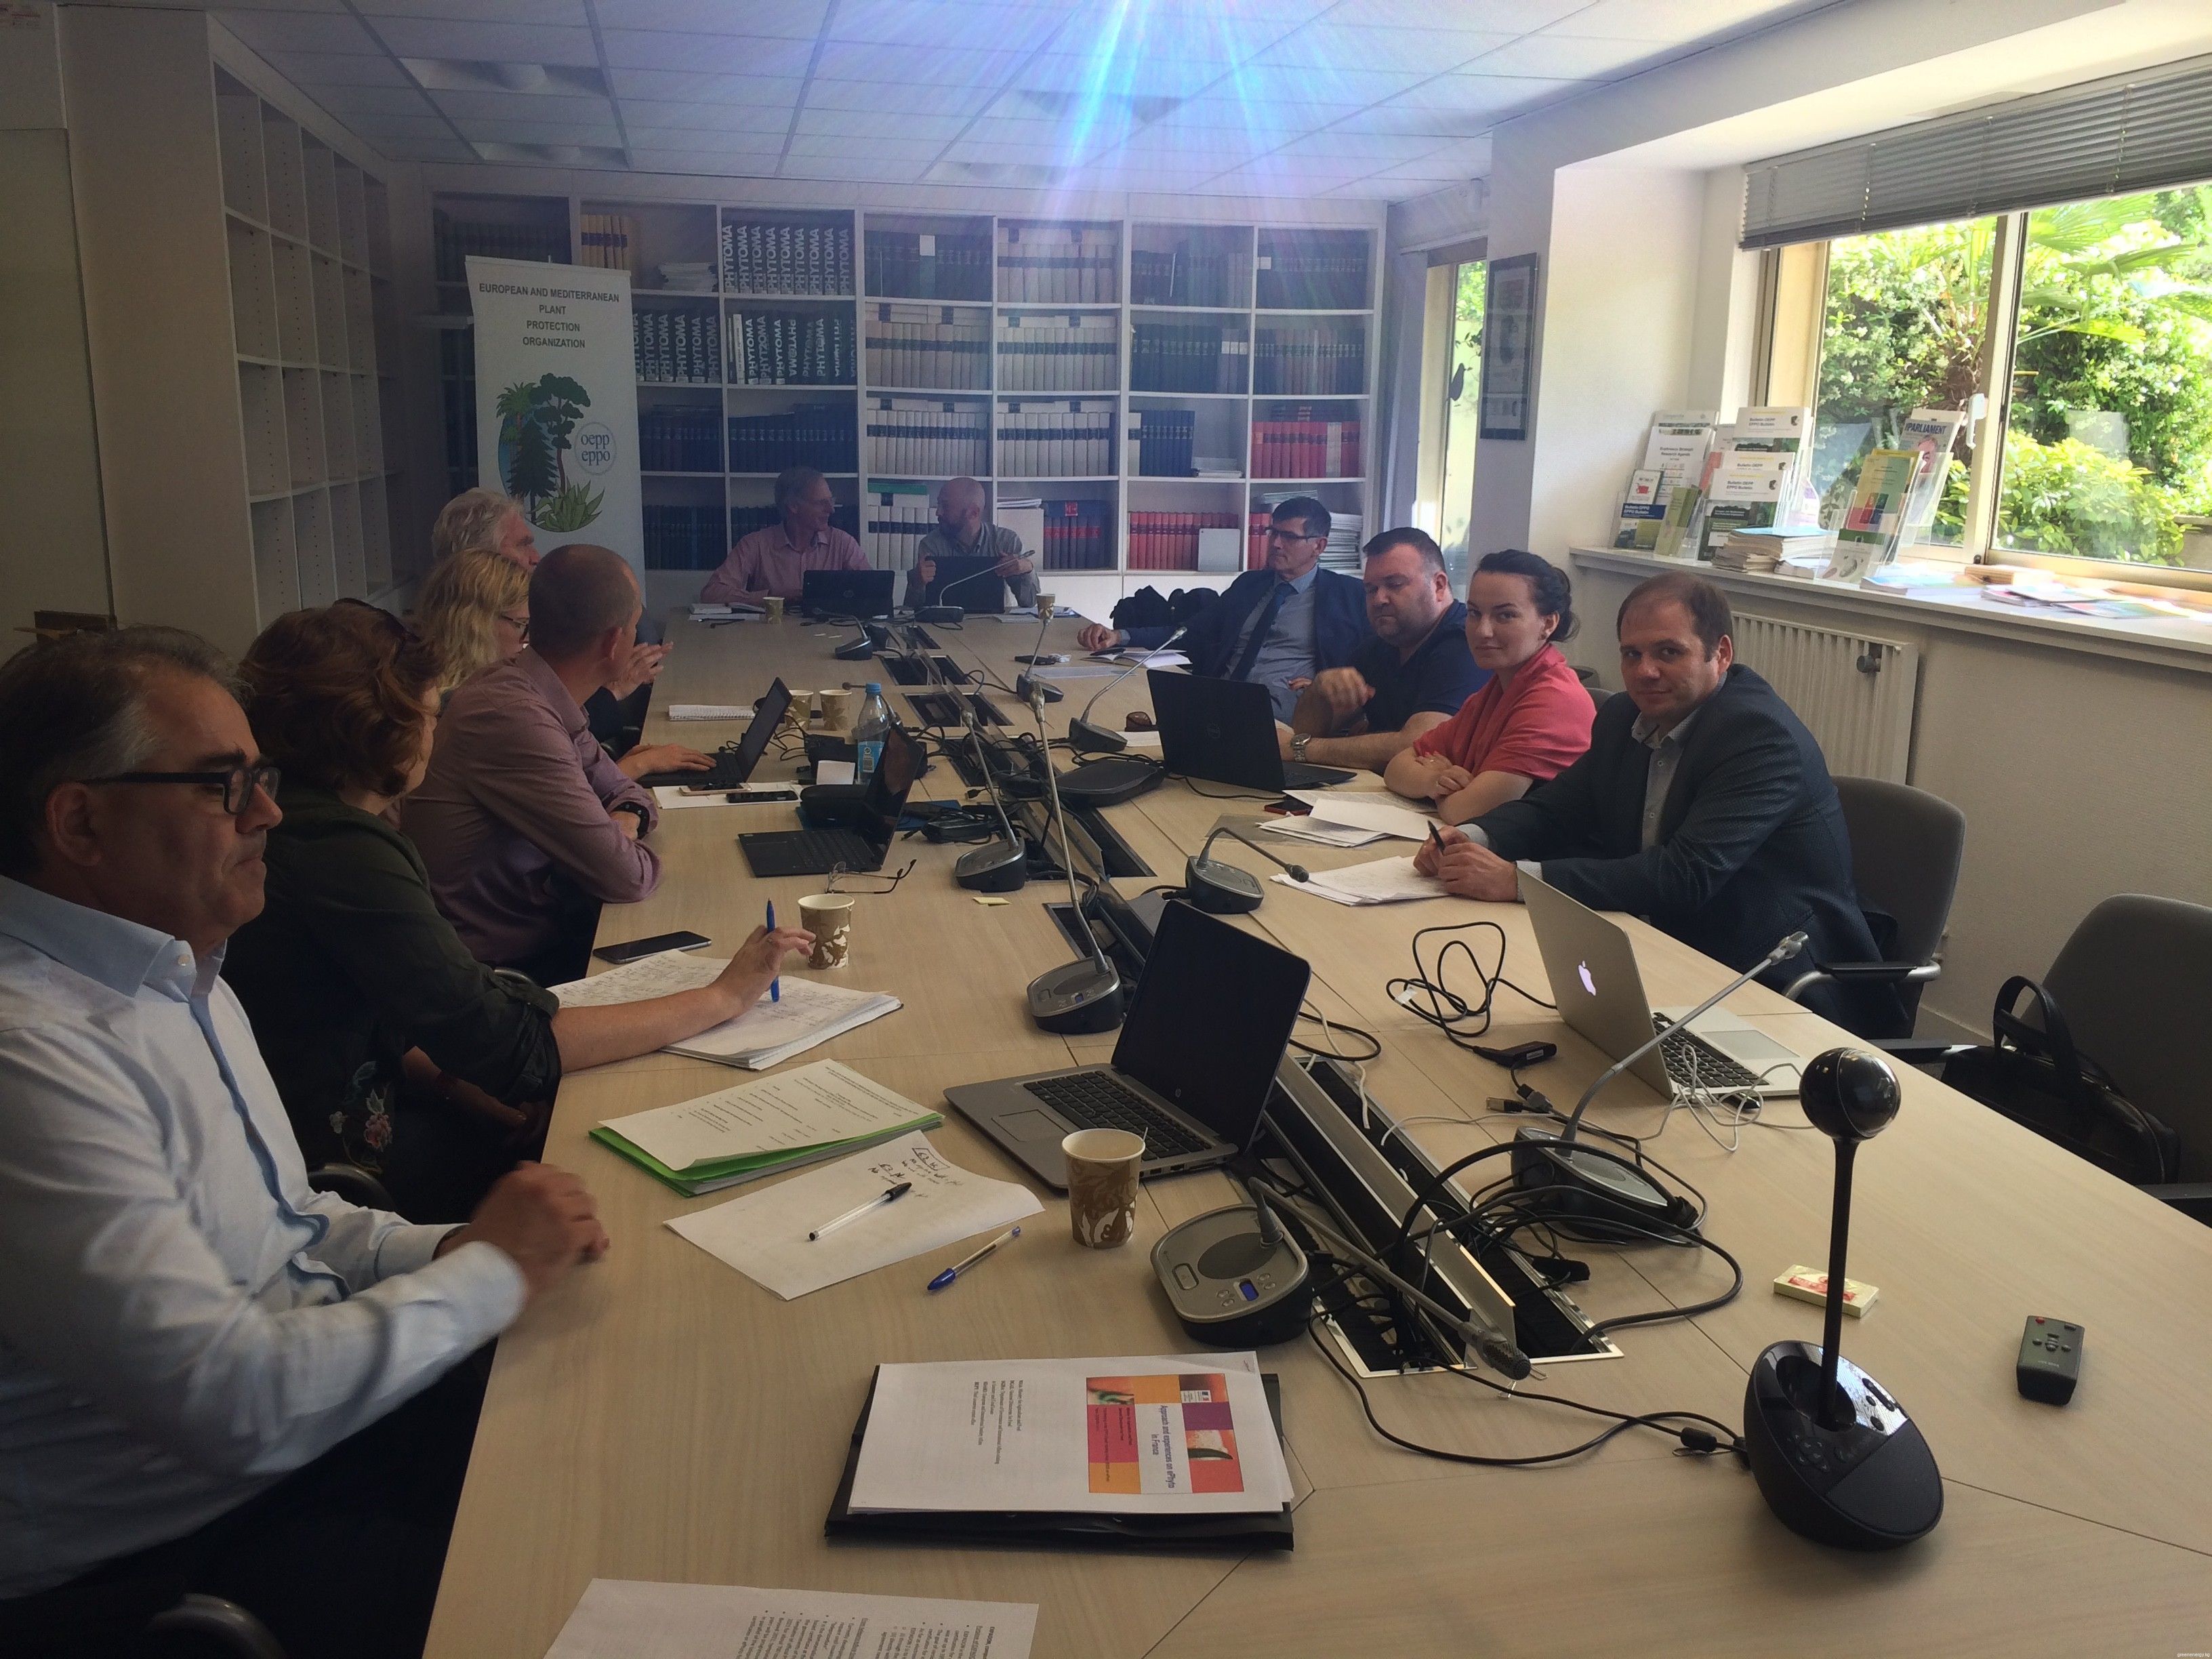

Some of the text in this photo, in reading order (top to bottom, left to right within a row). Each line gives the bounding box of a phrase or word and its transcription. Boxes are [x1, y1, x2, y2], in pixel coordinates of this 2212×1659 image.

[722, 225, 734, 288] PHYTOMA
[737, 226, 749, 289] PHYTOMA
[751, 226, 763, 289] PHYTOMA
[765, 228, 777, 290] PHYTOMA
[780, 227, 790, 291] PHYTOMA
[794, 228, 804, 291] PHYTOMA
[809, 228, 819, 292] PHYTOMA
[824, 228, 834, 291] PHYTOMA
[479, 283, 619, 302] EUROPEAN AND MEDITERRANEAN
[539, 305, 566, 314] PLANT
[523, 337, 585, 348] ORGANIZATION
[527, 321, 580, 331] PROTECTION
[643, 314, 655, 375] PHYTOMA
[658, 314, 670, 375] PHYTOMA
[674, 314, 687, 375] PHYTOMA
[691, 317, 702, 375] PHYTOMA
[706, 315, 718, 377] PHYTOMA
[745, 319, 757, 377] PHYTOMA
[774, 319, 783, 377] PHYTOMA
[581, 434, 610, 449] oepp
[1907, 422, 1946, 434] PARLIAMENT
[581, 451, 610, 466] eppo
[1158, 1405, 1170, 1425] Approach
[1151, 1439, 1160, 1455] France
[1162, 1435, 1172, 1462] experiences
